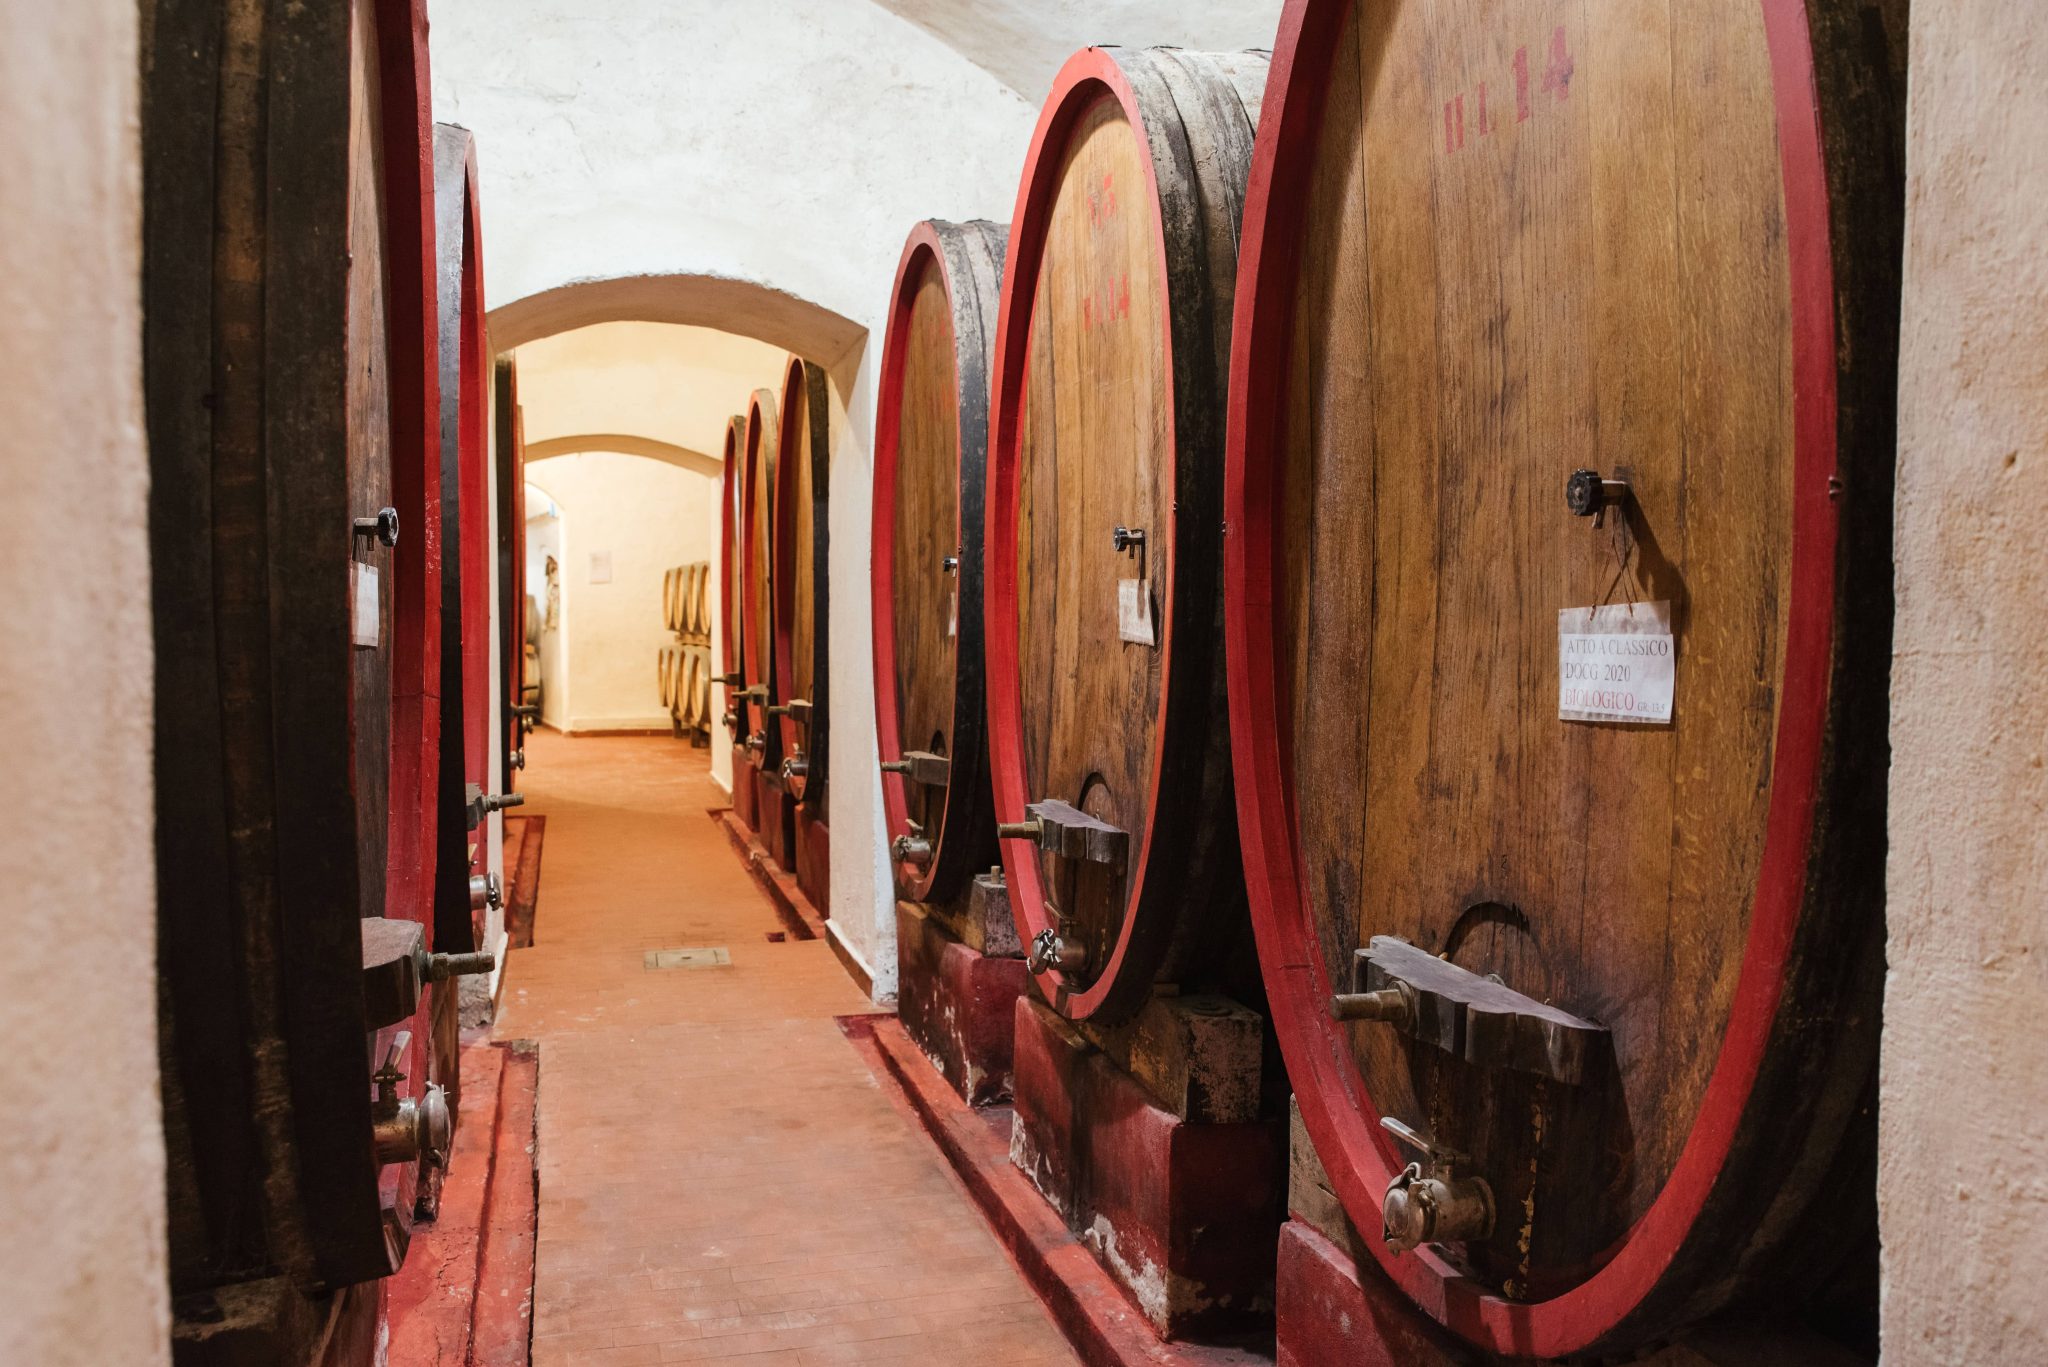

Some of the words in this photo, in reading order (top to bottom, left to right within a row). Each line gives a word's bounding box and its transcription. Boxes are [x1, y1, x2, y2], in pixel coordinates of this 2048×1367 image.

[1567, 638, 1596, 655] ATTO
[1608, 639, 1668, 657] CLASSICO
[1565, 662, 1599, 680] DOCG
[1604, 664, 1631, 682] 2020
[1564, 688, 1635, 711] BIOLOGICO
